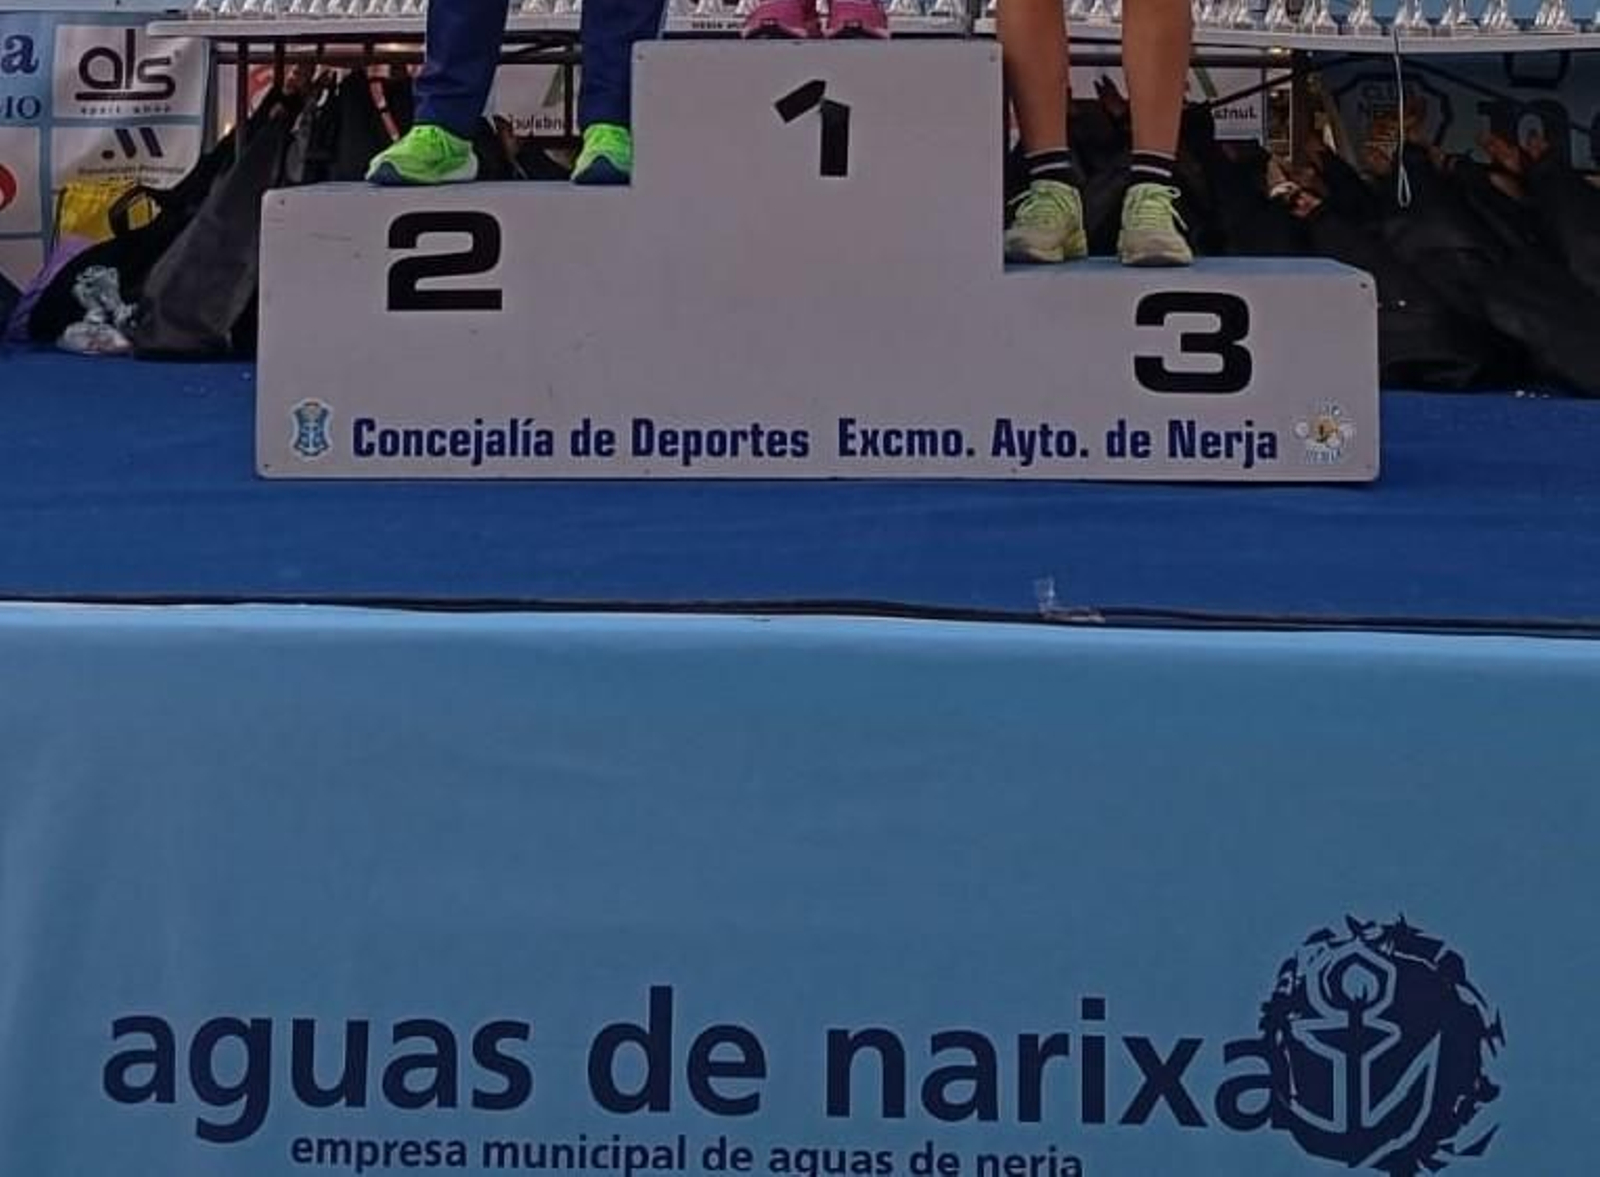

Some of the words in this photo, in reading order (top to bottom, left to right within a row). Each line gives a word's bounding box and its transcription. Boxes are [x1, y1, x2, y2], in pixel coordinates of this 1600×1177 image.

[774, 79, 851, 177] 1
[387, 210, 502, 312] 2
[1134, 291, 1253, 394] 3
[353, 417, 554, 466] Concejalía
[570, 419, 616, 458] de
[632, 418, 810, 466] Deportes
[838, 417, 975, 459] Excmo.
[991, 417, 1089, 467] Ayto.
[1106, 419, 1151, 459] de
[1168, 420, 1278, 469] Nerja
[103, 1013, 533, 1143] aguas
[588, 985, 768, 1116] de
[291, 1135, 467, 1173] empresa
[482, 1134, 687, 1177] municipal
[702, 1135, 754, 1171] de
[768, 1143, 894, 1177] aguas
[909, 1141, 960, 1176] de
